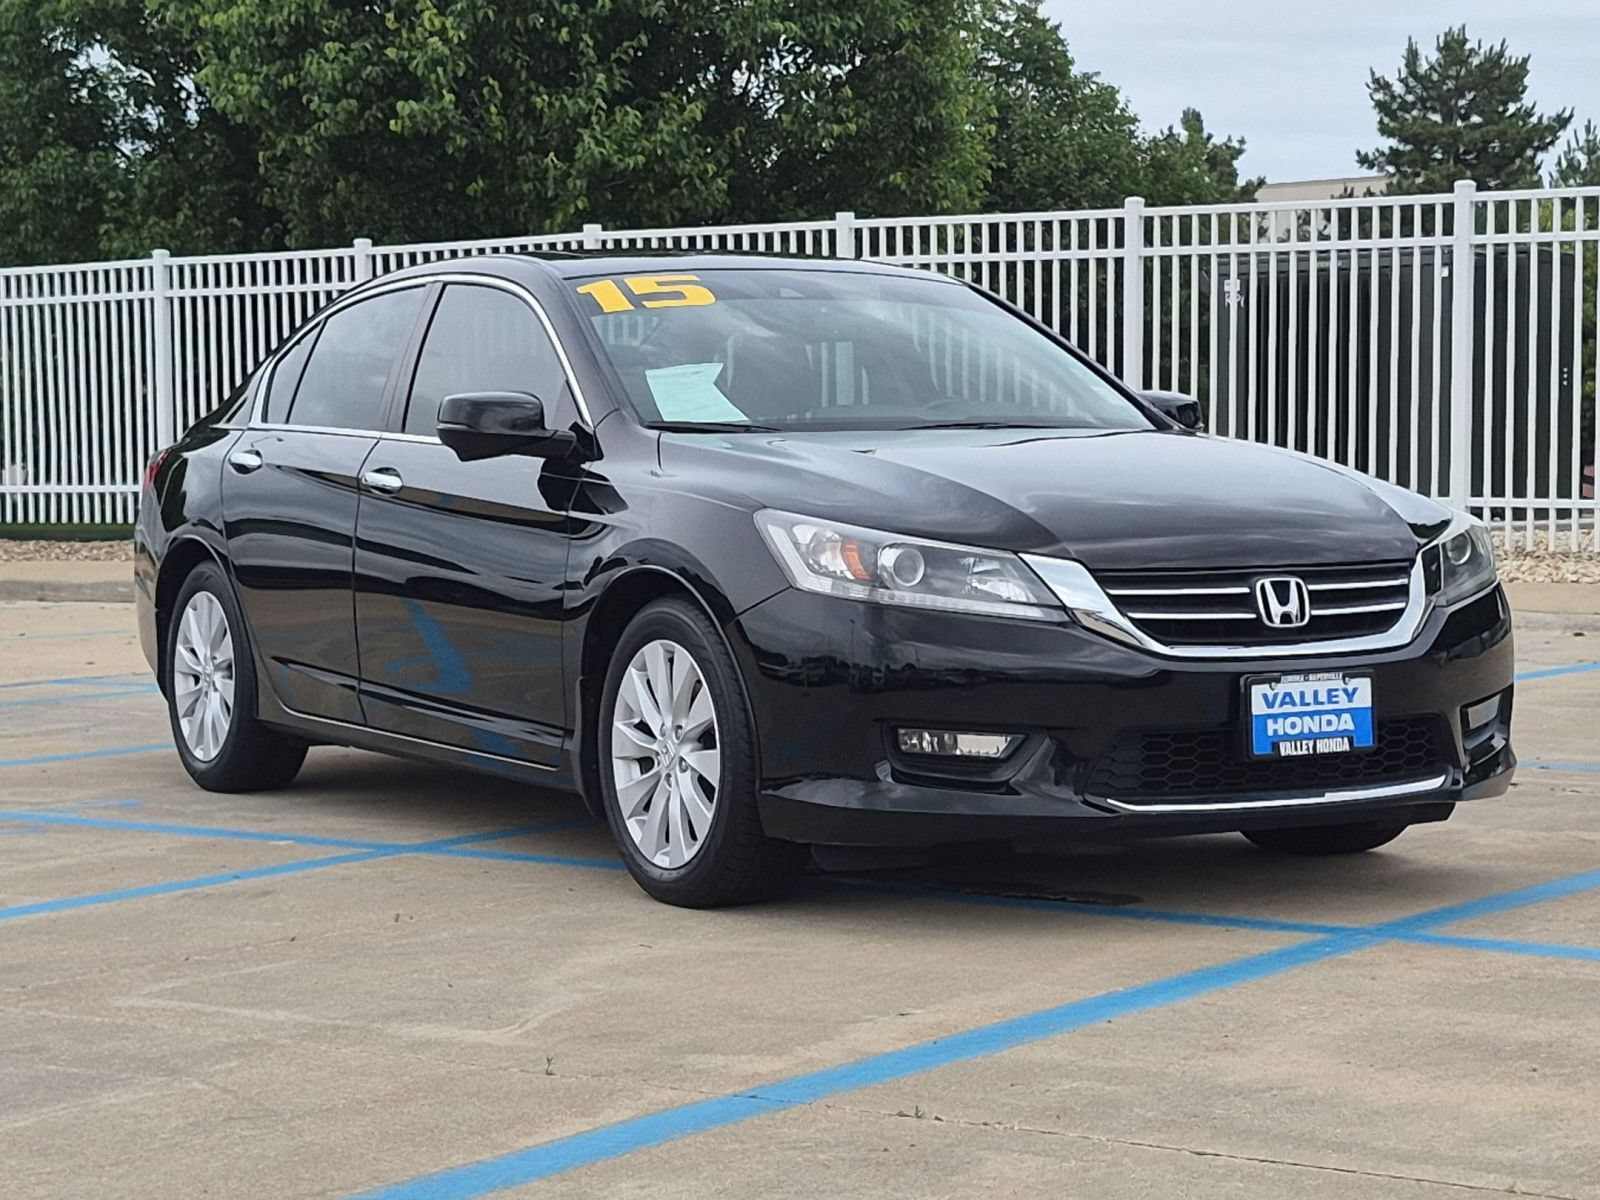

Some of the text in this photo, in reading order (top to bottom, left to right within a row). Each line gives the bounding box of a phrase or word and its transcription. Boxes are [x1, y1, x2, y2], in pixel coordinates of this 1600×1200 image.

[576, 275, 716, 313] 15
[1261, 687, 1359, 709] VALLEY
[1266, 713, 1355, 736] HONDA
[1280, 736, 1350, 757] VALLEY HONDA
